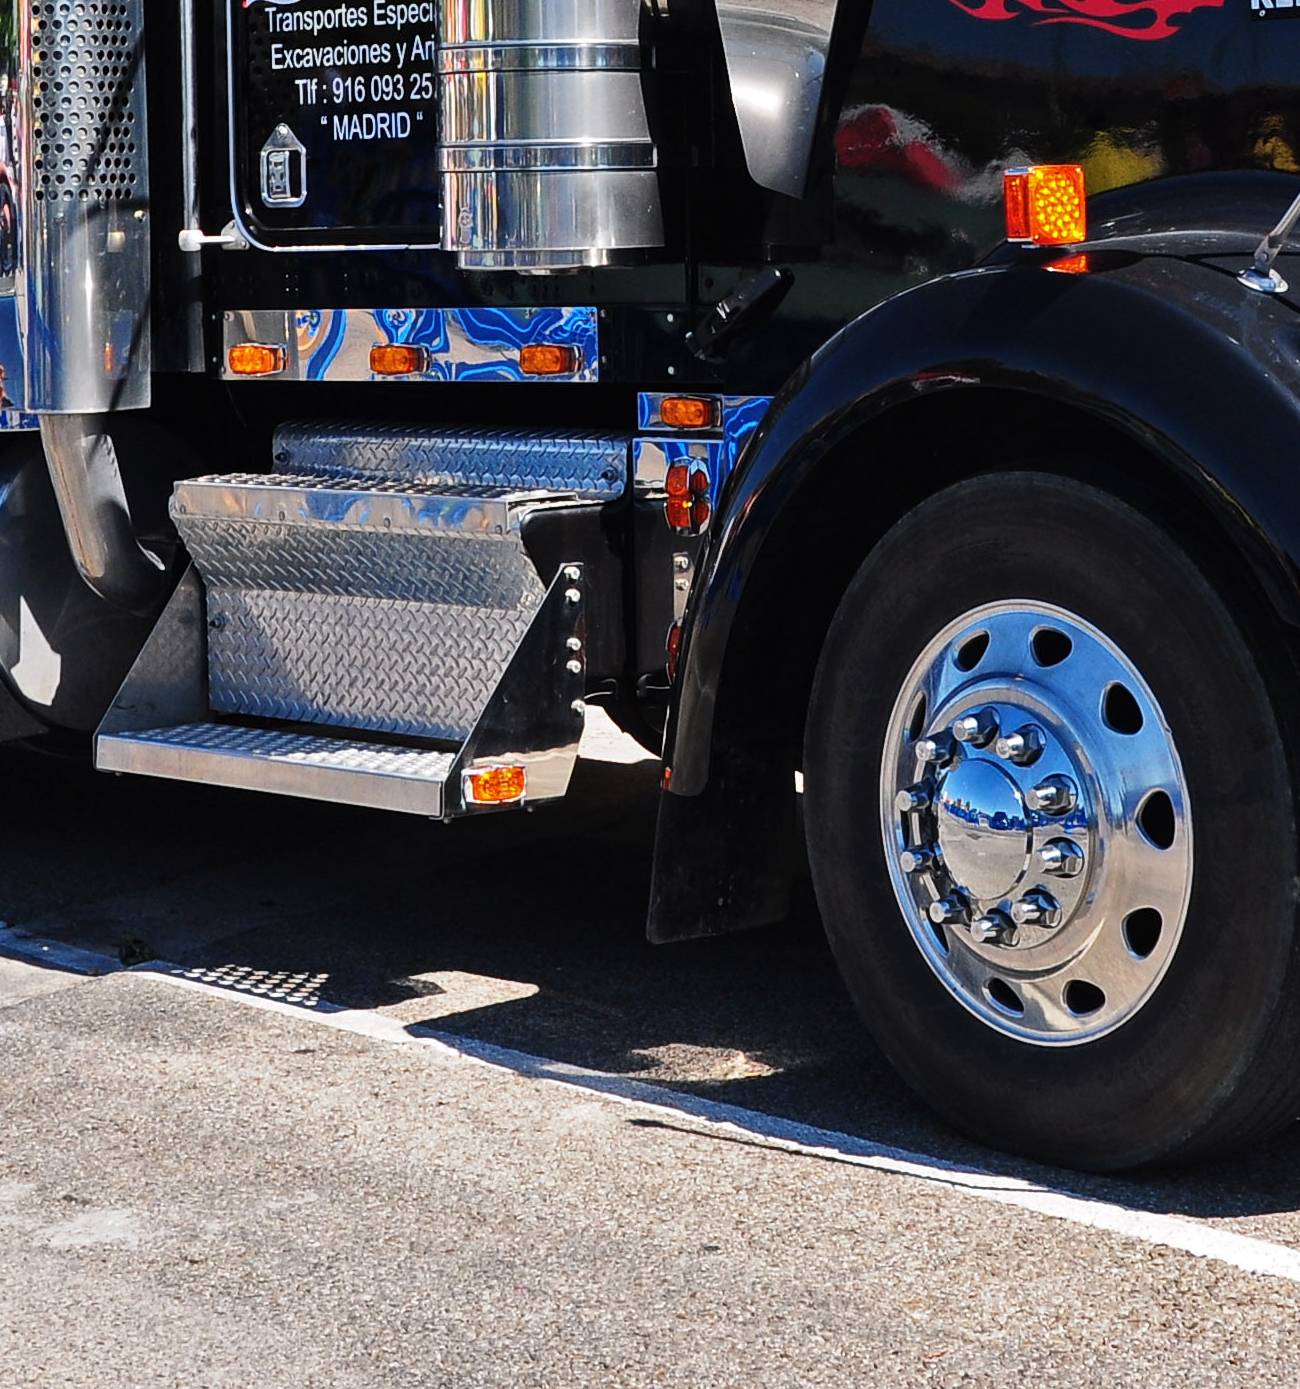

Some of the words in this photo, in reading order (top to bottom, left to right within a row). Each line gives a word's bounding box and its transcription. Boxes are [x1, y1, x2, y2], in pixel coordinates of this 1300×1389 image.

[264, 3, 368, 37] Transportes
[271, 39, 392, 70] Excavaciones
[396, 42, 407, 69] y
[411, 34, 436, 62] Ari
[332, 76, 366, 104] 916
[371, 74, 404, 102] 093
[410, 73, 433, 100] 25
